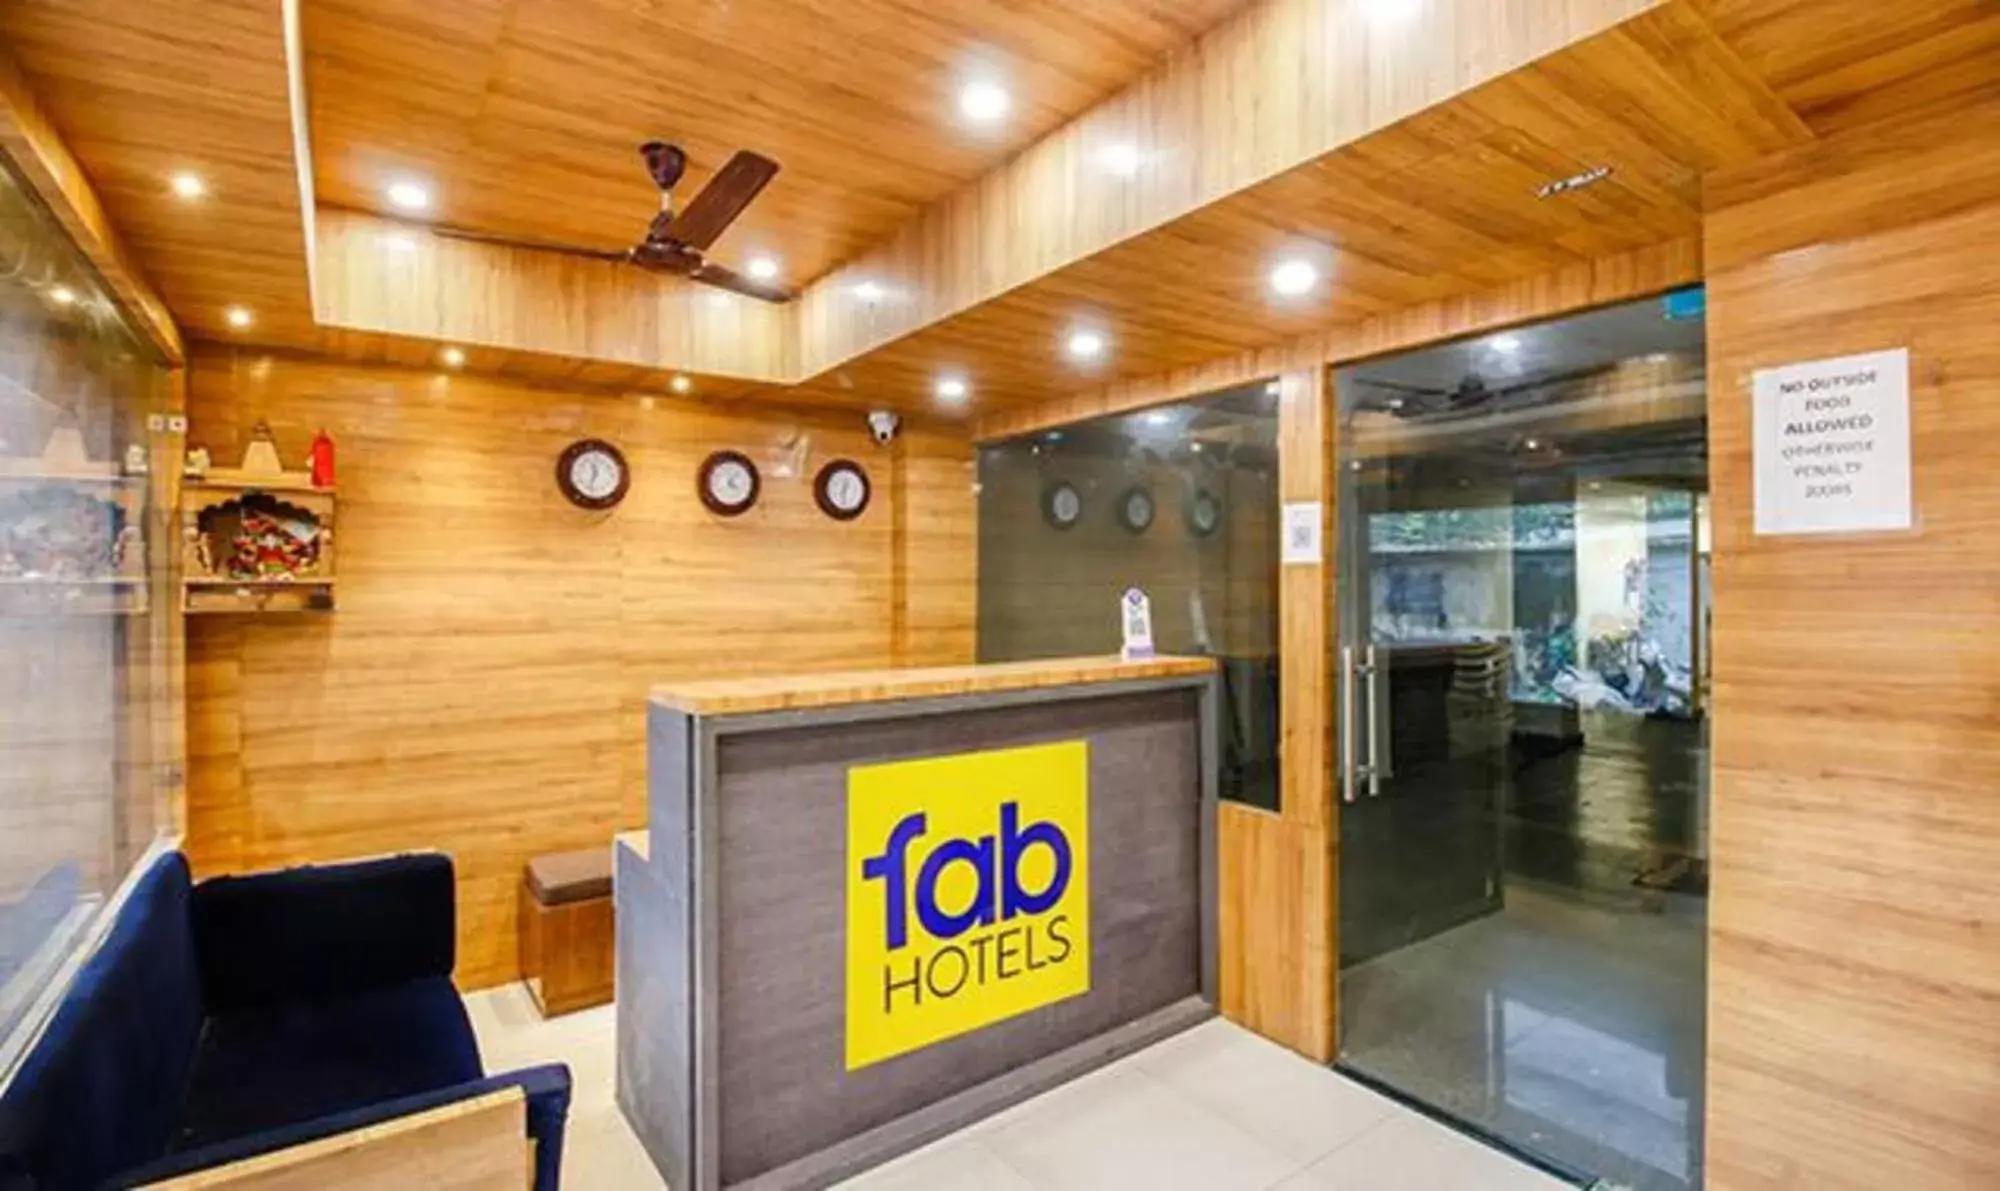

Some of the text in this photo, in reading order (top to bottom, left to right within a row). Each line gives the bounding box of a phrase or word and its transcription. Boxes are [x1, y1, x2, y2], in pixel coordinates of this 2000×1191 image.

[1780, 371, 1877, 394] NO OUTSIDE
[1805, 396, 1851, 411] FOOD
[1784, 414, 1873, 436] ALLOWED
[862, 801, 1072, 950] fab
[884, 915, 1072, 1013] HOTELS
